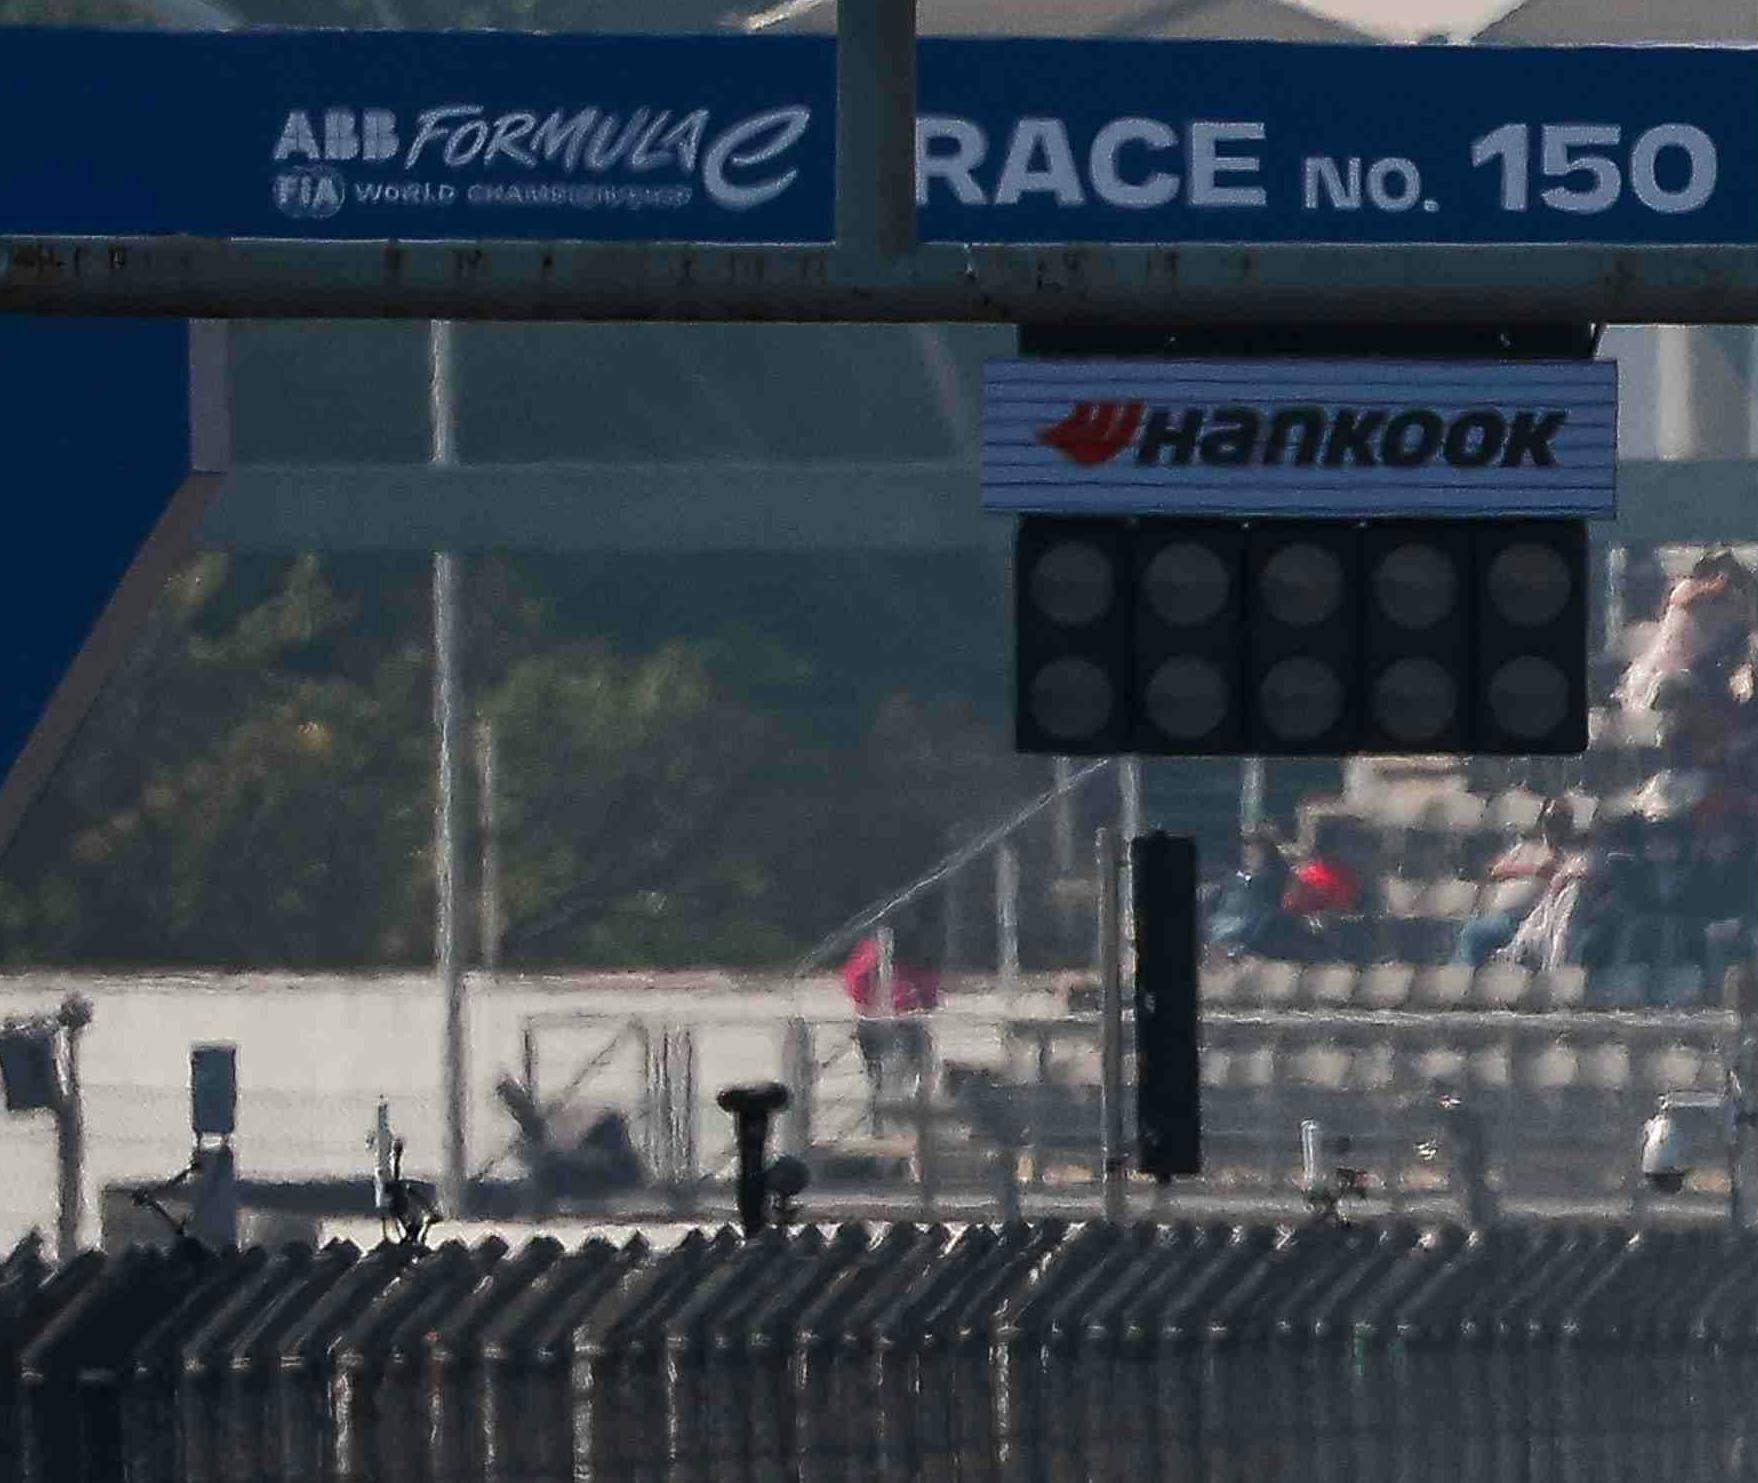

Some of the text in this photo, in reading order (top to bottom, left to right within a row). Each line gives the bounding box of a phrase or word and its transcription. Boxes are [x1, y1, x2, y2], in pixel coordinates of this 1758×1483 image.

[274, 108, 399, 161] ABB
[405, 105, 710, 170] FORMULA
[915, 116, 1268, 206] RACE
[1470, 121, 1718, 213] 150
[276, 175, 339, 206] FIA
[354, 183, 455, 202] WORLD
